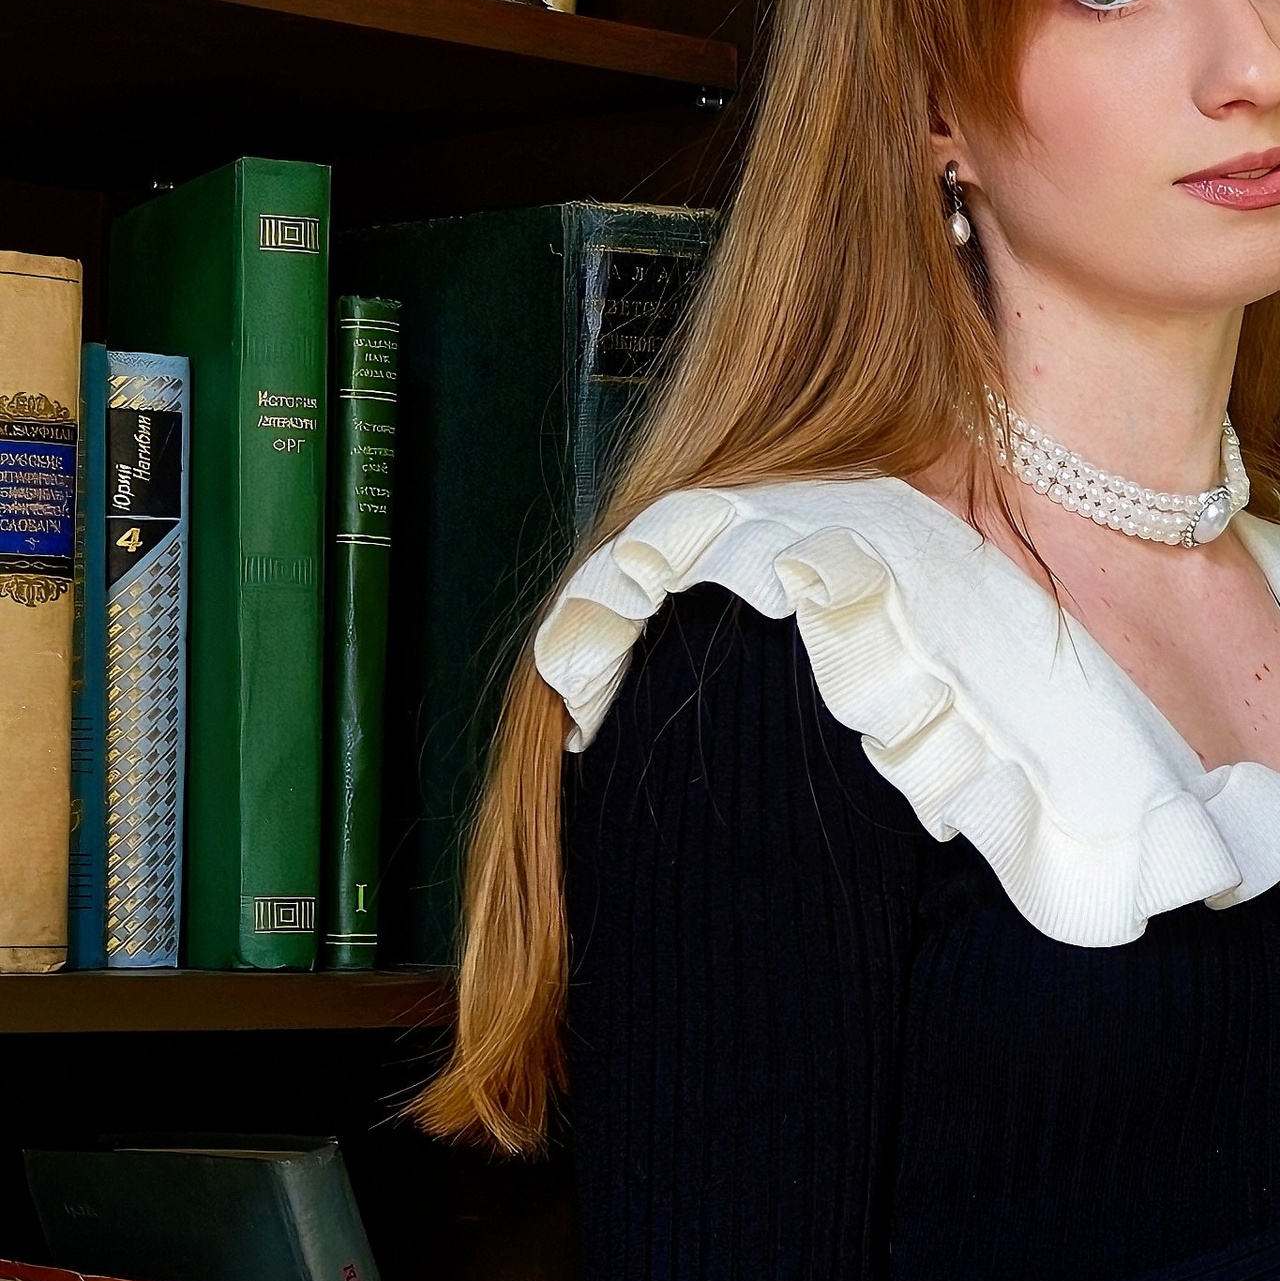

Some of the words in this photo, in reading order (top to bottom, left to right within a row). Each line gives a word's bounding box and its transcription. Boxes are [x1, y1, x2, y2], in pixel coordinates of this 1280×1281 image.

[132, 414, 152, 482] Нагибин
[111, 462, 136, 512] Юрий
[115, 527, 143, 553] 4
